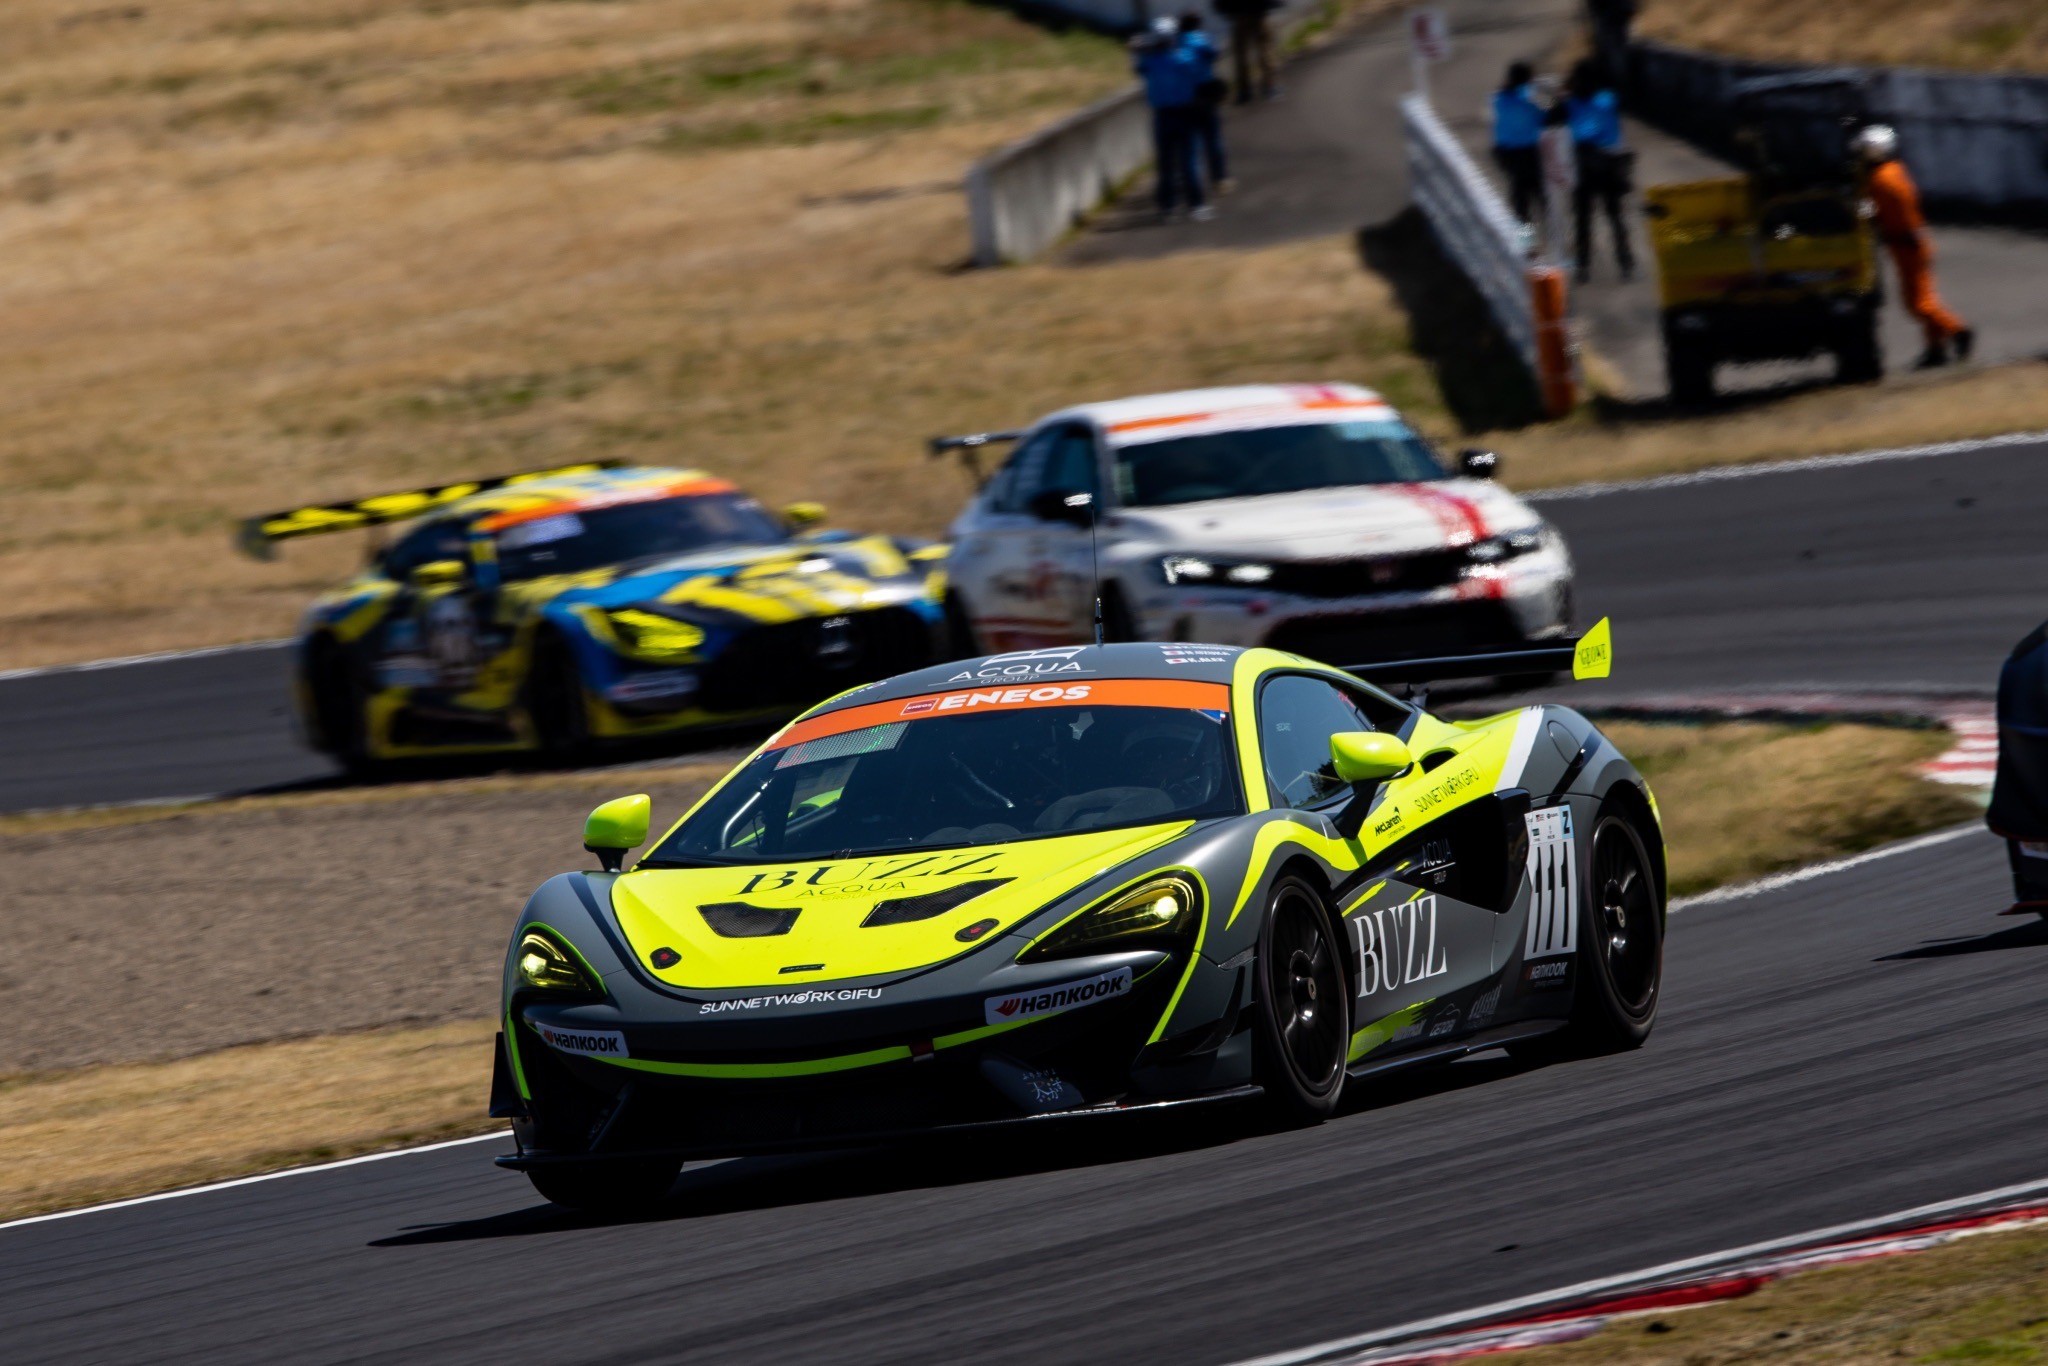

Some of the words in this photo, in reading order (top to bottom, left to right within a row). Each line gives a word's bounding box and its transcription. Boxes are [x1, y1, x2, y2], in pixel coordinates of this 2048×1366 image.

[948, 661, 1082, 682] ACQUA
[980, 674, 1040, 684] GROUP
[938, 685, 1092, 710] ENEOS
[1374, 815, 1402, 836] McLaren
[730, 852, 1006, 896] BUZZ
[795, 881, 906, 898] ACQUA
[1532, 841, 1569, 953] 111
[1353, 895, 1447, 998] BUZZ
[699, 990, 836, 1014] SUNNETWORK
[838, 988, 882, 1000] GIFU
